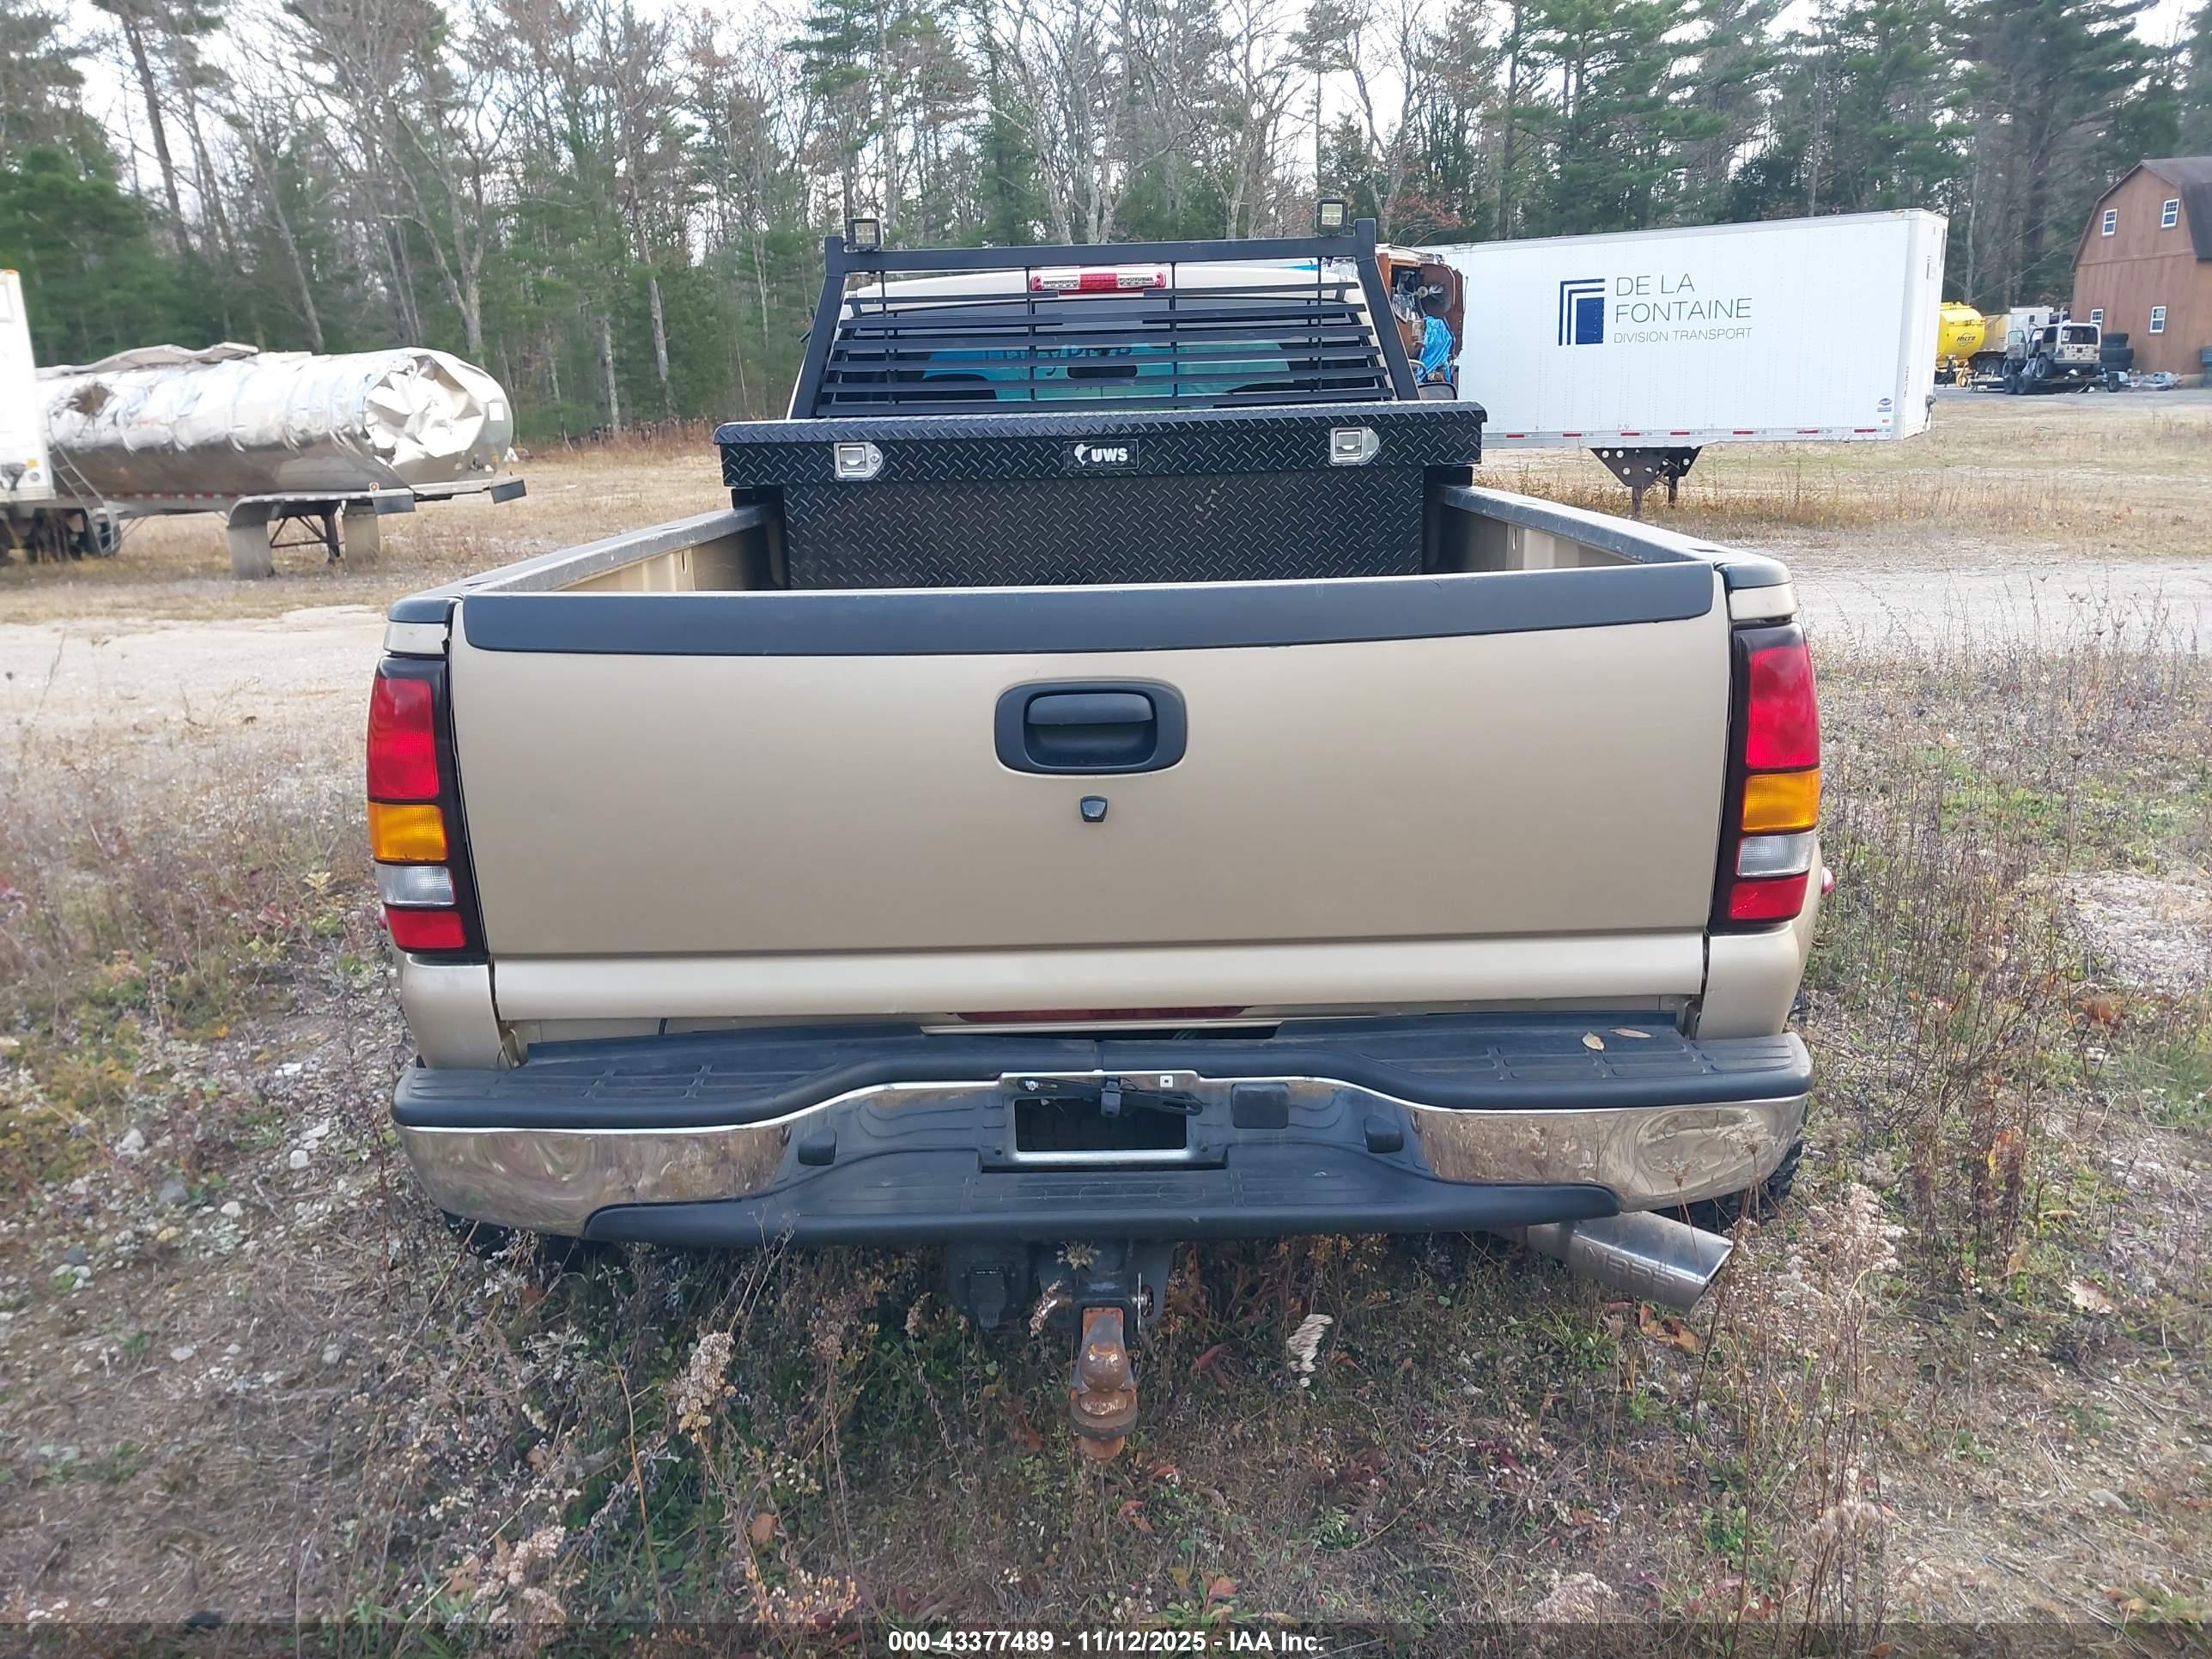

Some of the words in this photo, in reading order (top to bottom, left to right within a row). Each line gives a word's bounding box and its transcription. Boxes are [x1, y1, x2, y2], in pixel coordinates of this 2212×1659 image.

[1616, 275, 1651, 296] DE
[1661, 273, 1695, 295] LA
[1615, 298, 1753, 323] FONTAINE
[1613, 331, 1668, 343] DIVISION
[1673, 327, 1753, 341] TRANSPORT
[1091, 447, 1128, 462] UWS
